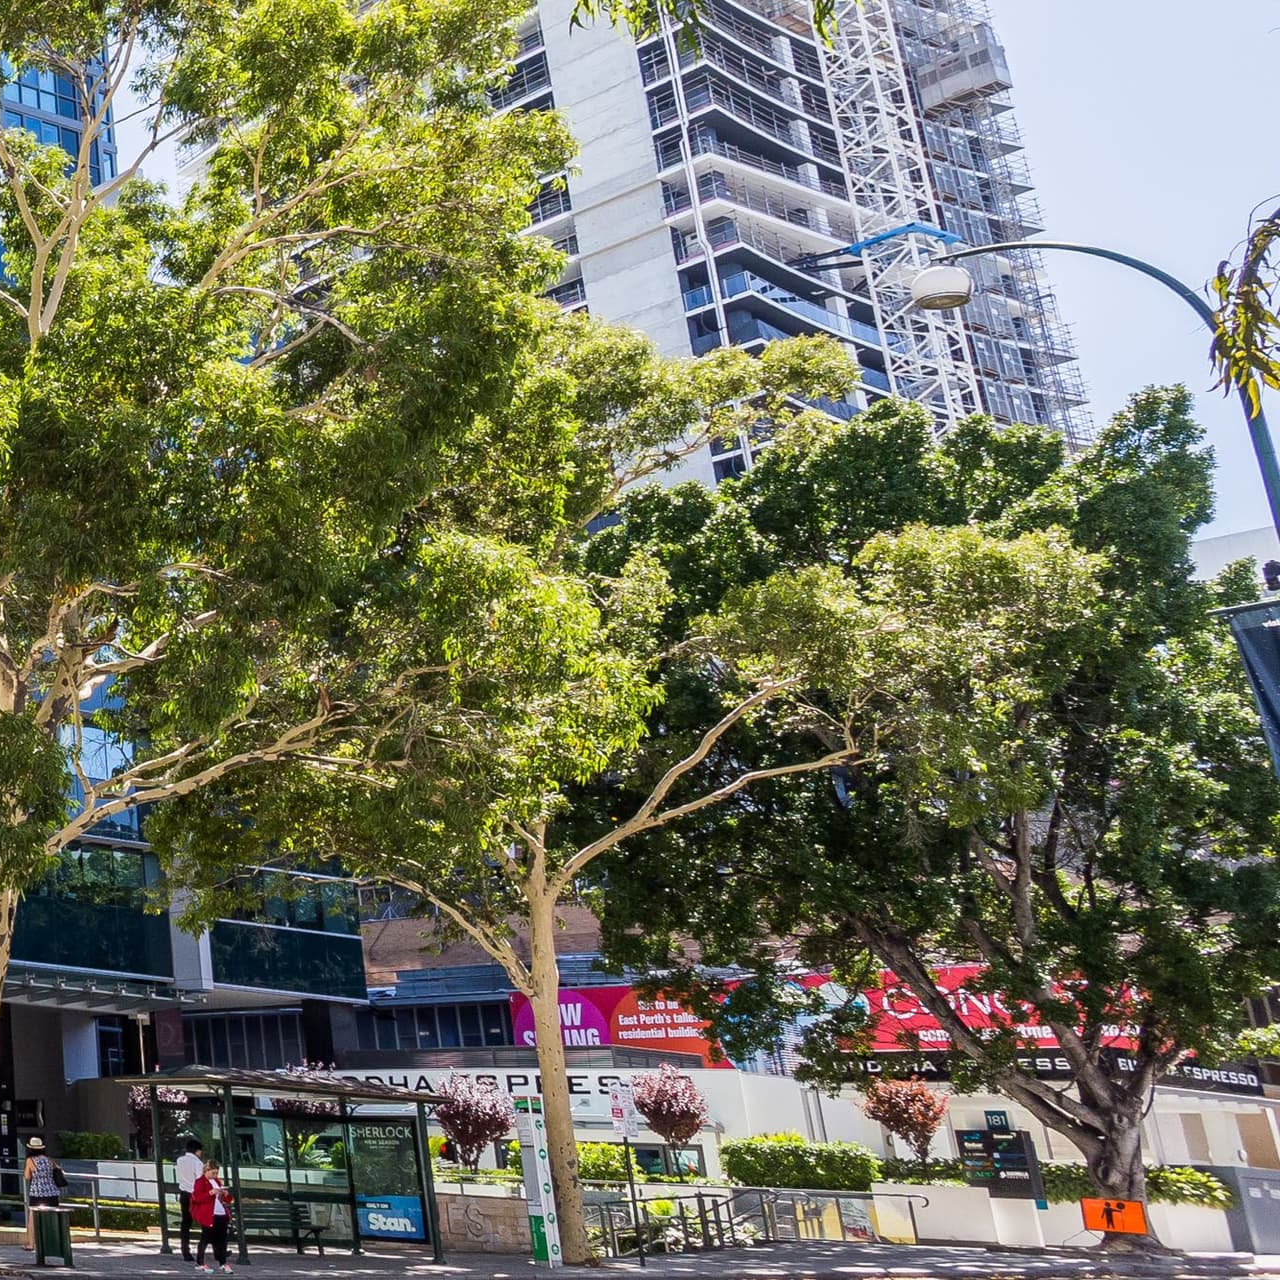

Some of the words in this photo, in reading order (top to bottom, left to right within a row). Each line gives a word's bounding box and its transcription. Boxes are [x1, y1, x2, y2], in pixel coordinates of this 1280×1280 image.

[618, 1014, 638, 1025] East
[639, 1012, 671, 1024] Perth's
[523, 1028, 600, 1046] SING
[618, 1027, 666, 1039] residential
[1183, 1066, 1258, 1087] ESPRESSO
[987, 1115, 1006, 1126] 181
[350, 1126, 412, 1138] SHERLOCK
[368, 1212, 416, 1232] Stan.
